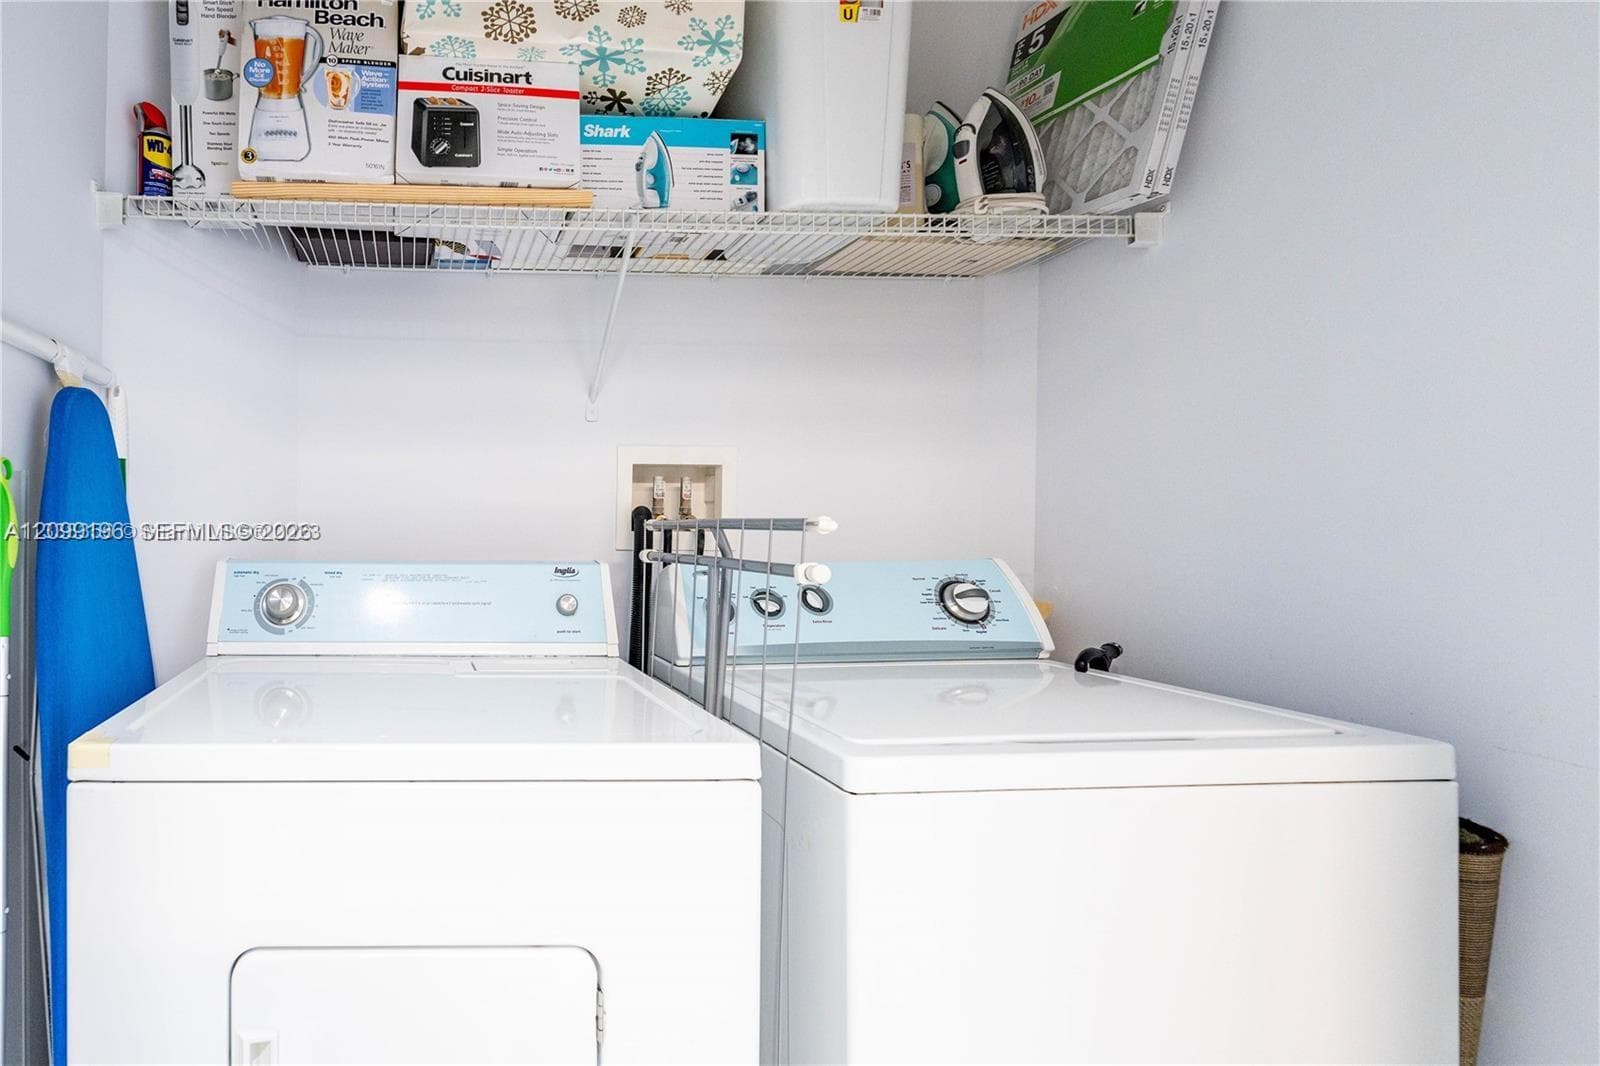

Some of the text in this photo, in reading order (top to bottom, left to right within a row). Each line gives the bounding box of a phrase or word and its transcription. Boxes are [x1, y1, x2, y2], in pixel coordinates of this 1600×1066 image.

[315, 10, 384, 28] Beach
[329, 27, 365, 42] Wave
[1028, 25, 1046, 54] 5
[442, 67, 533, 85] Cuisinart
[451, 85, 478, 93] Compact
[583, 123, 632, 139] Shark
[246, 151, 253, 160] 3
[1144, 169, 1156, 188] HDX
[1162, 166, 1174, 187] HDX
[553, 566, 576, 576] Inglis
